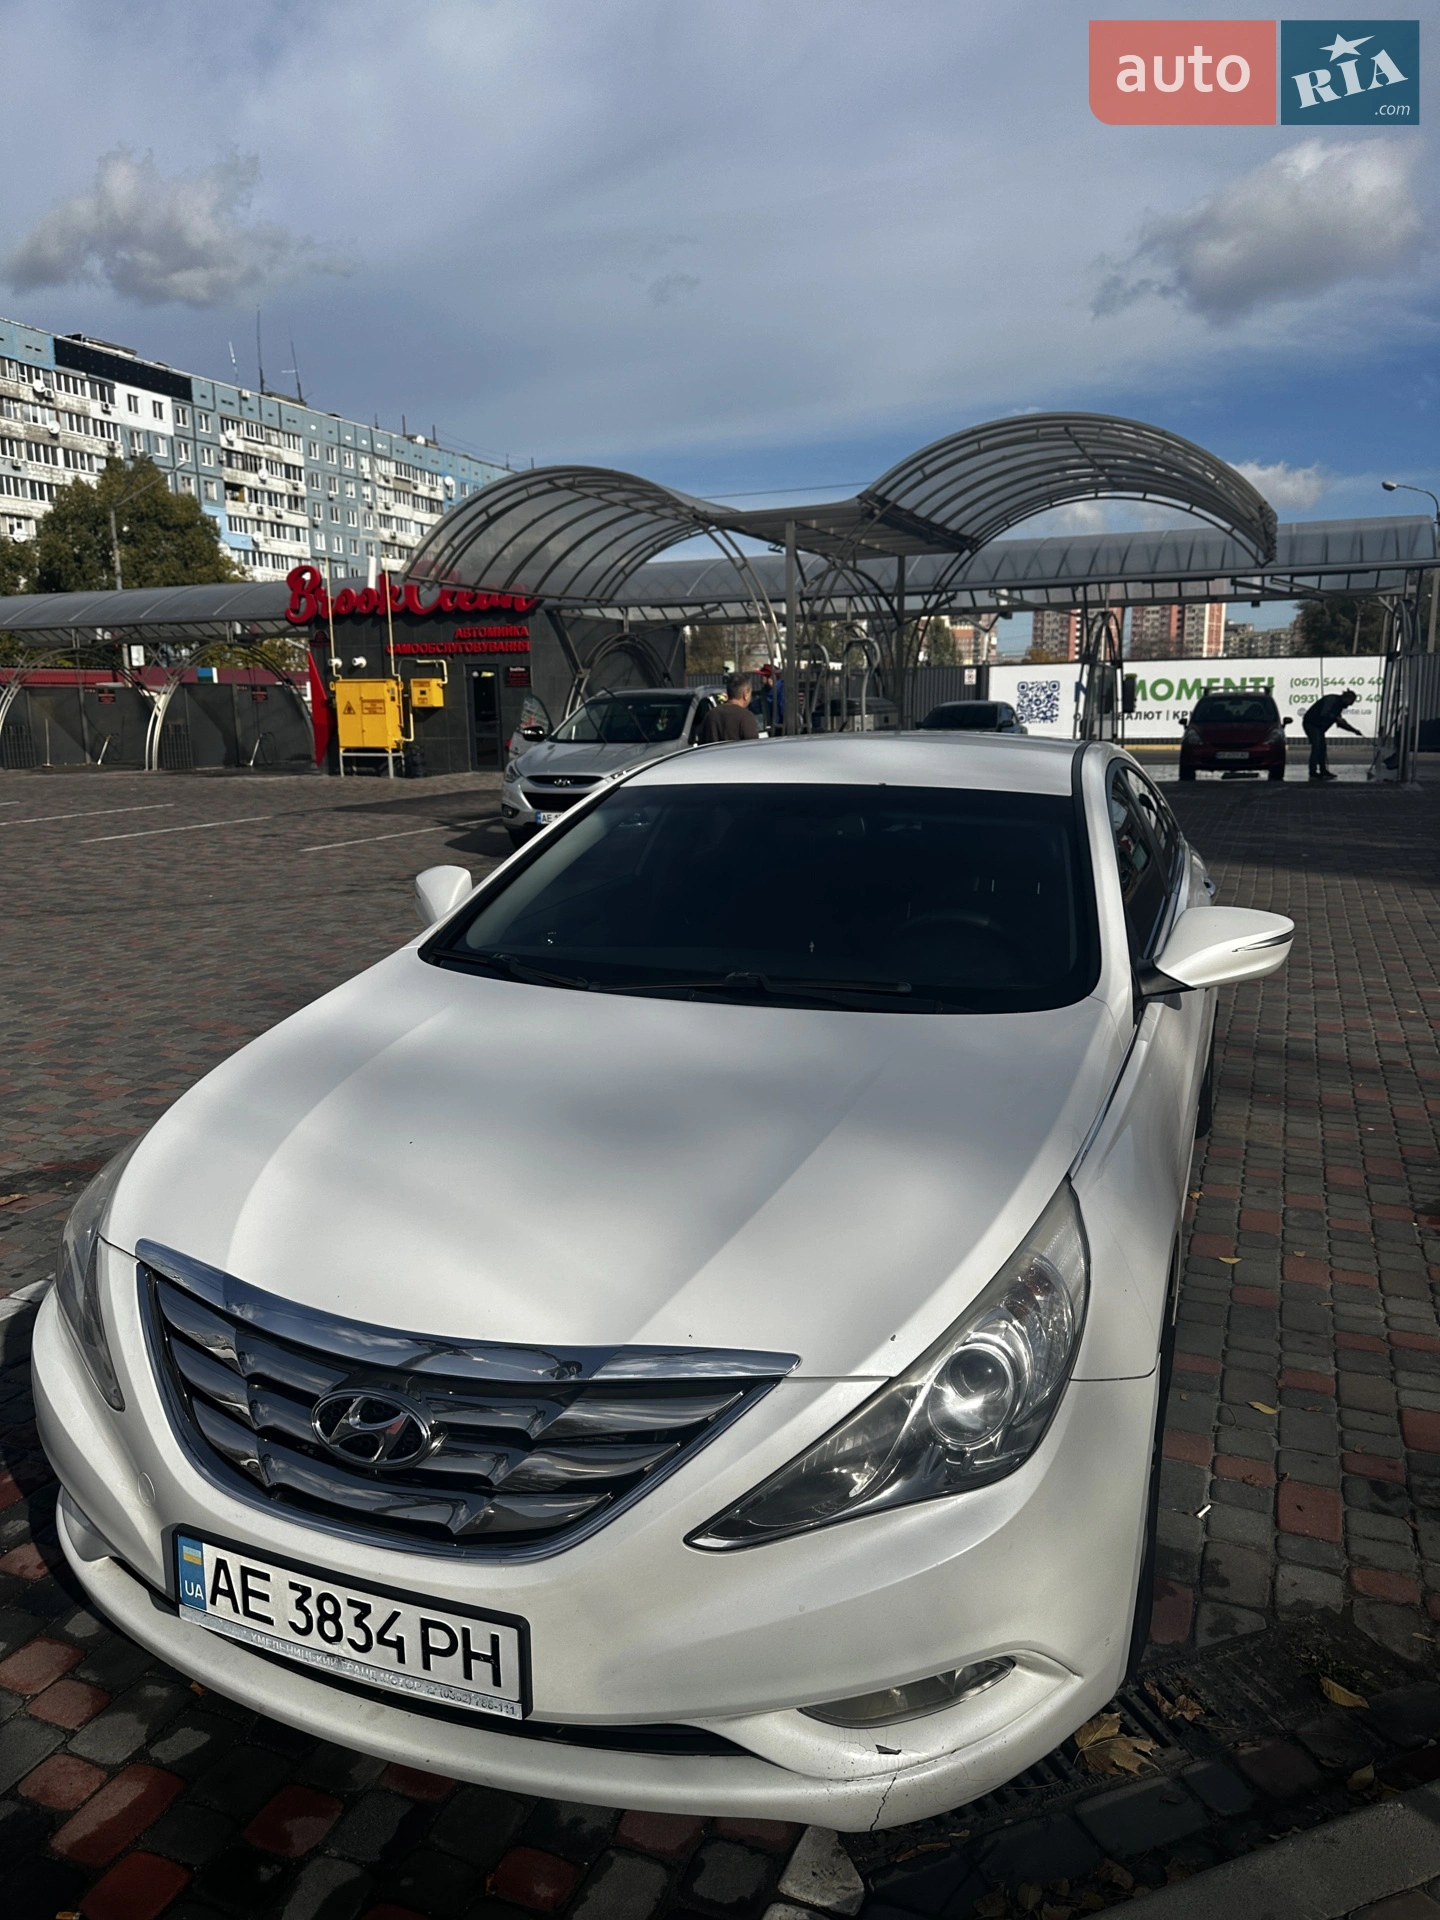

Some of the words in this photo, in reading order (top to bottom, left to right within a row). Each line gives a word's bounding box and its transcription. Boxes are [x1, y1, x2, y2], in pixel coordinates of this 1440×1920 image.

[455, 624, 530, 639] АВТОМИЙКА
[386, 641, 531, 655] САМООБСЛУГОВУВАННЯ
[1290, 677, 1320, 689] (067)
[1322, 677, 1346, 687] 544
[1348, 677, 1365, 687] 40
[1367, 676, 1384, 686] 40
[1365, 693, 1383, 703] 40
[184, 1580, 205, 1601] UA
[208, 1556, 275, 1627] AE
[287, 1580, 406, 1665] 3834
[420, 1616, 502, 1688] PH
